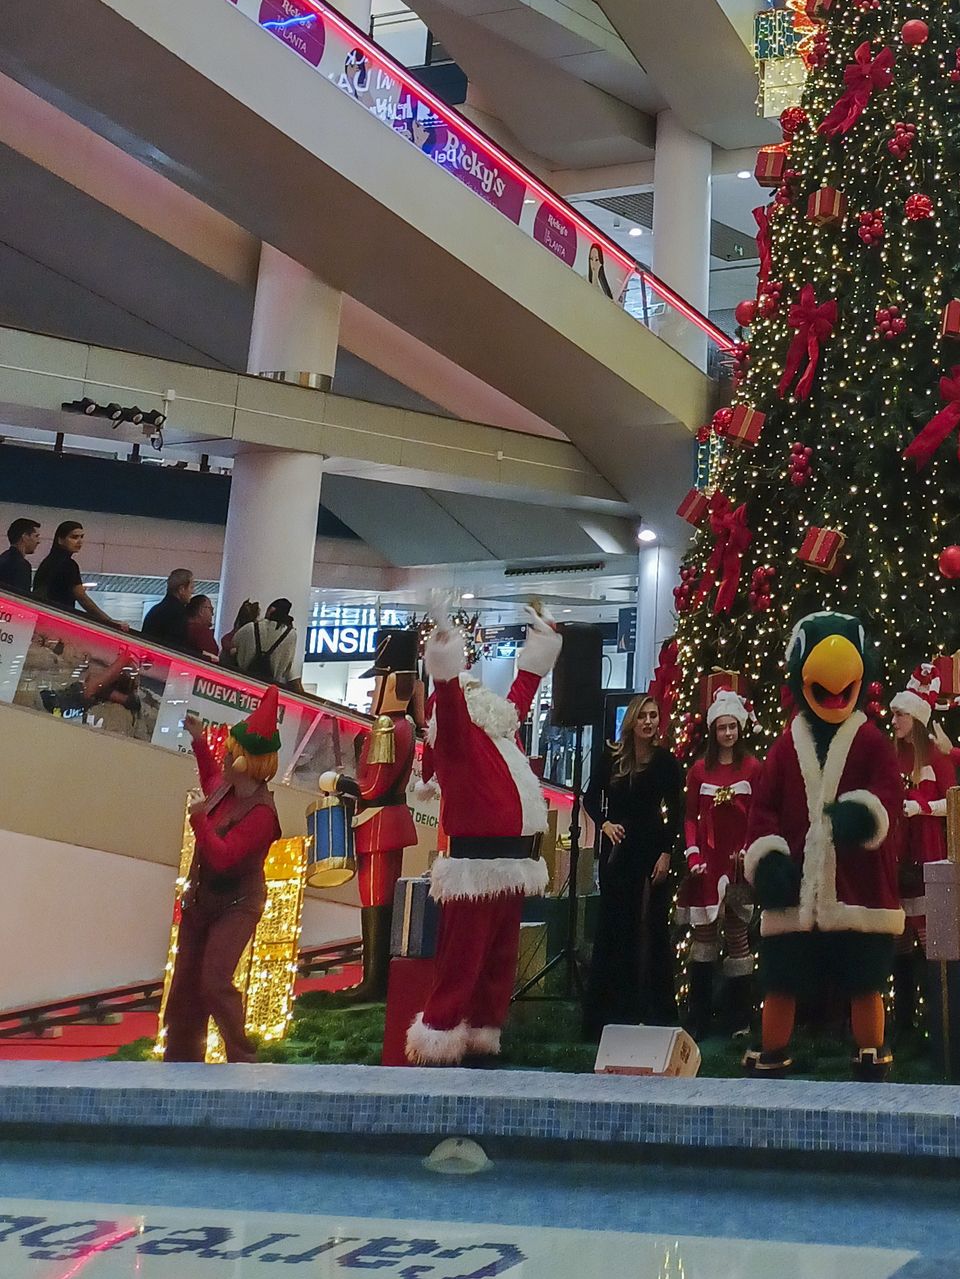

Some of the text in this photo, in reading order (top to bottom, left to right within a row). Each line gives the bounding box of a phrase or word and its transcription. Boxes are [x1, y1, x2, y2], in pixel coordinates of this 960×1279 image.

[443, 129, 506, 198] Ricky's
[0, 609, 12, 623] ro
[196, 678, 238, 705] NUEVA
[415, 812, 440, 828] DEICH
